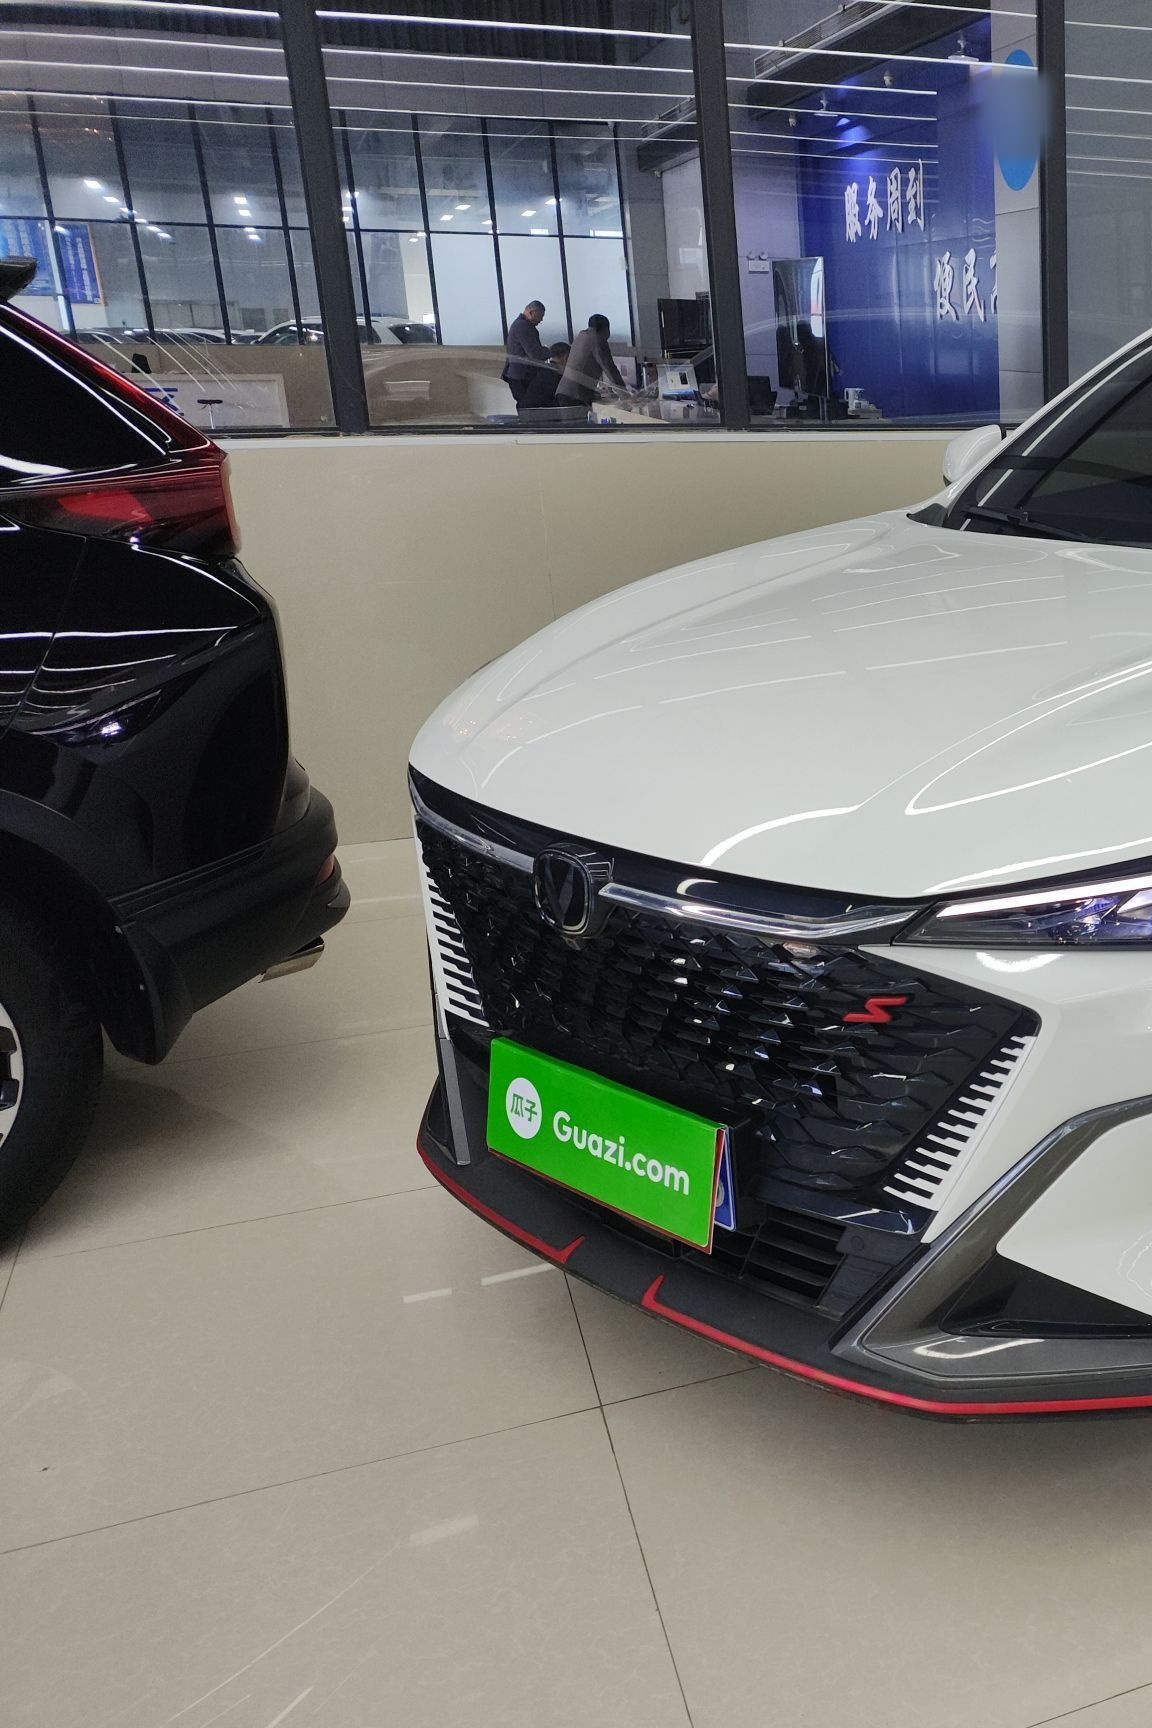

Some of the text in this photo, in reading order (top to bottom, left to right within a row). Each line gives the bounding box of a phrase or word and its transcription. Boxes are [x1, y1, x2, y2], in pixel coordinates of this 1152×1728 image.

[844, 159, 925, 243] 服务周到
[934, 248, 998, 322] 便民
[510, 1093, 538, 1122] 瓜子
[553, 1111, 689, 1195] Guazi.com
